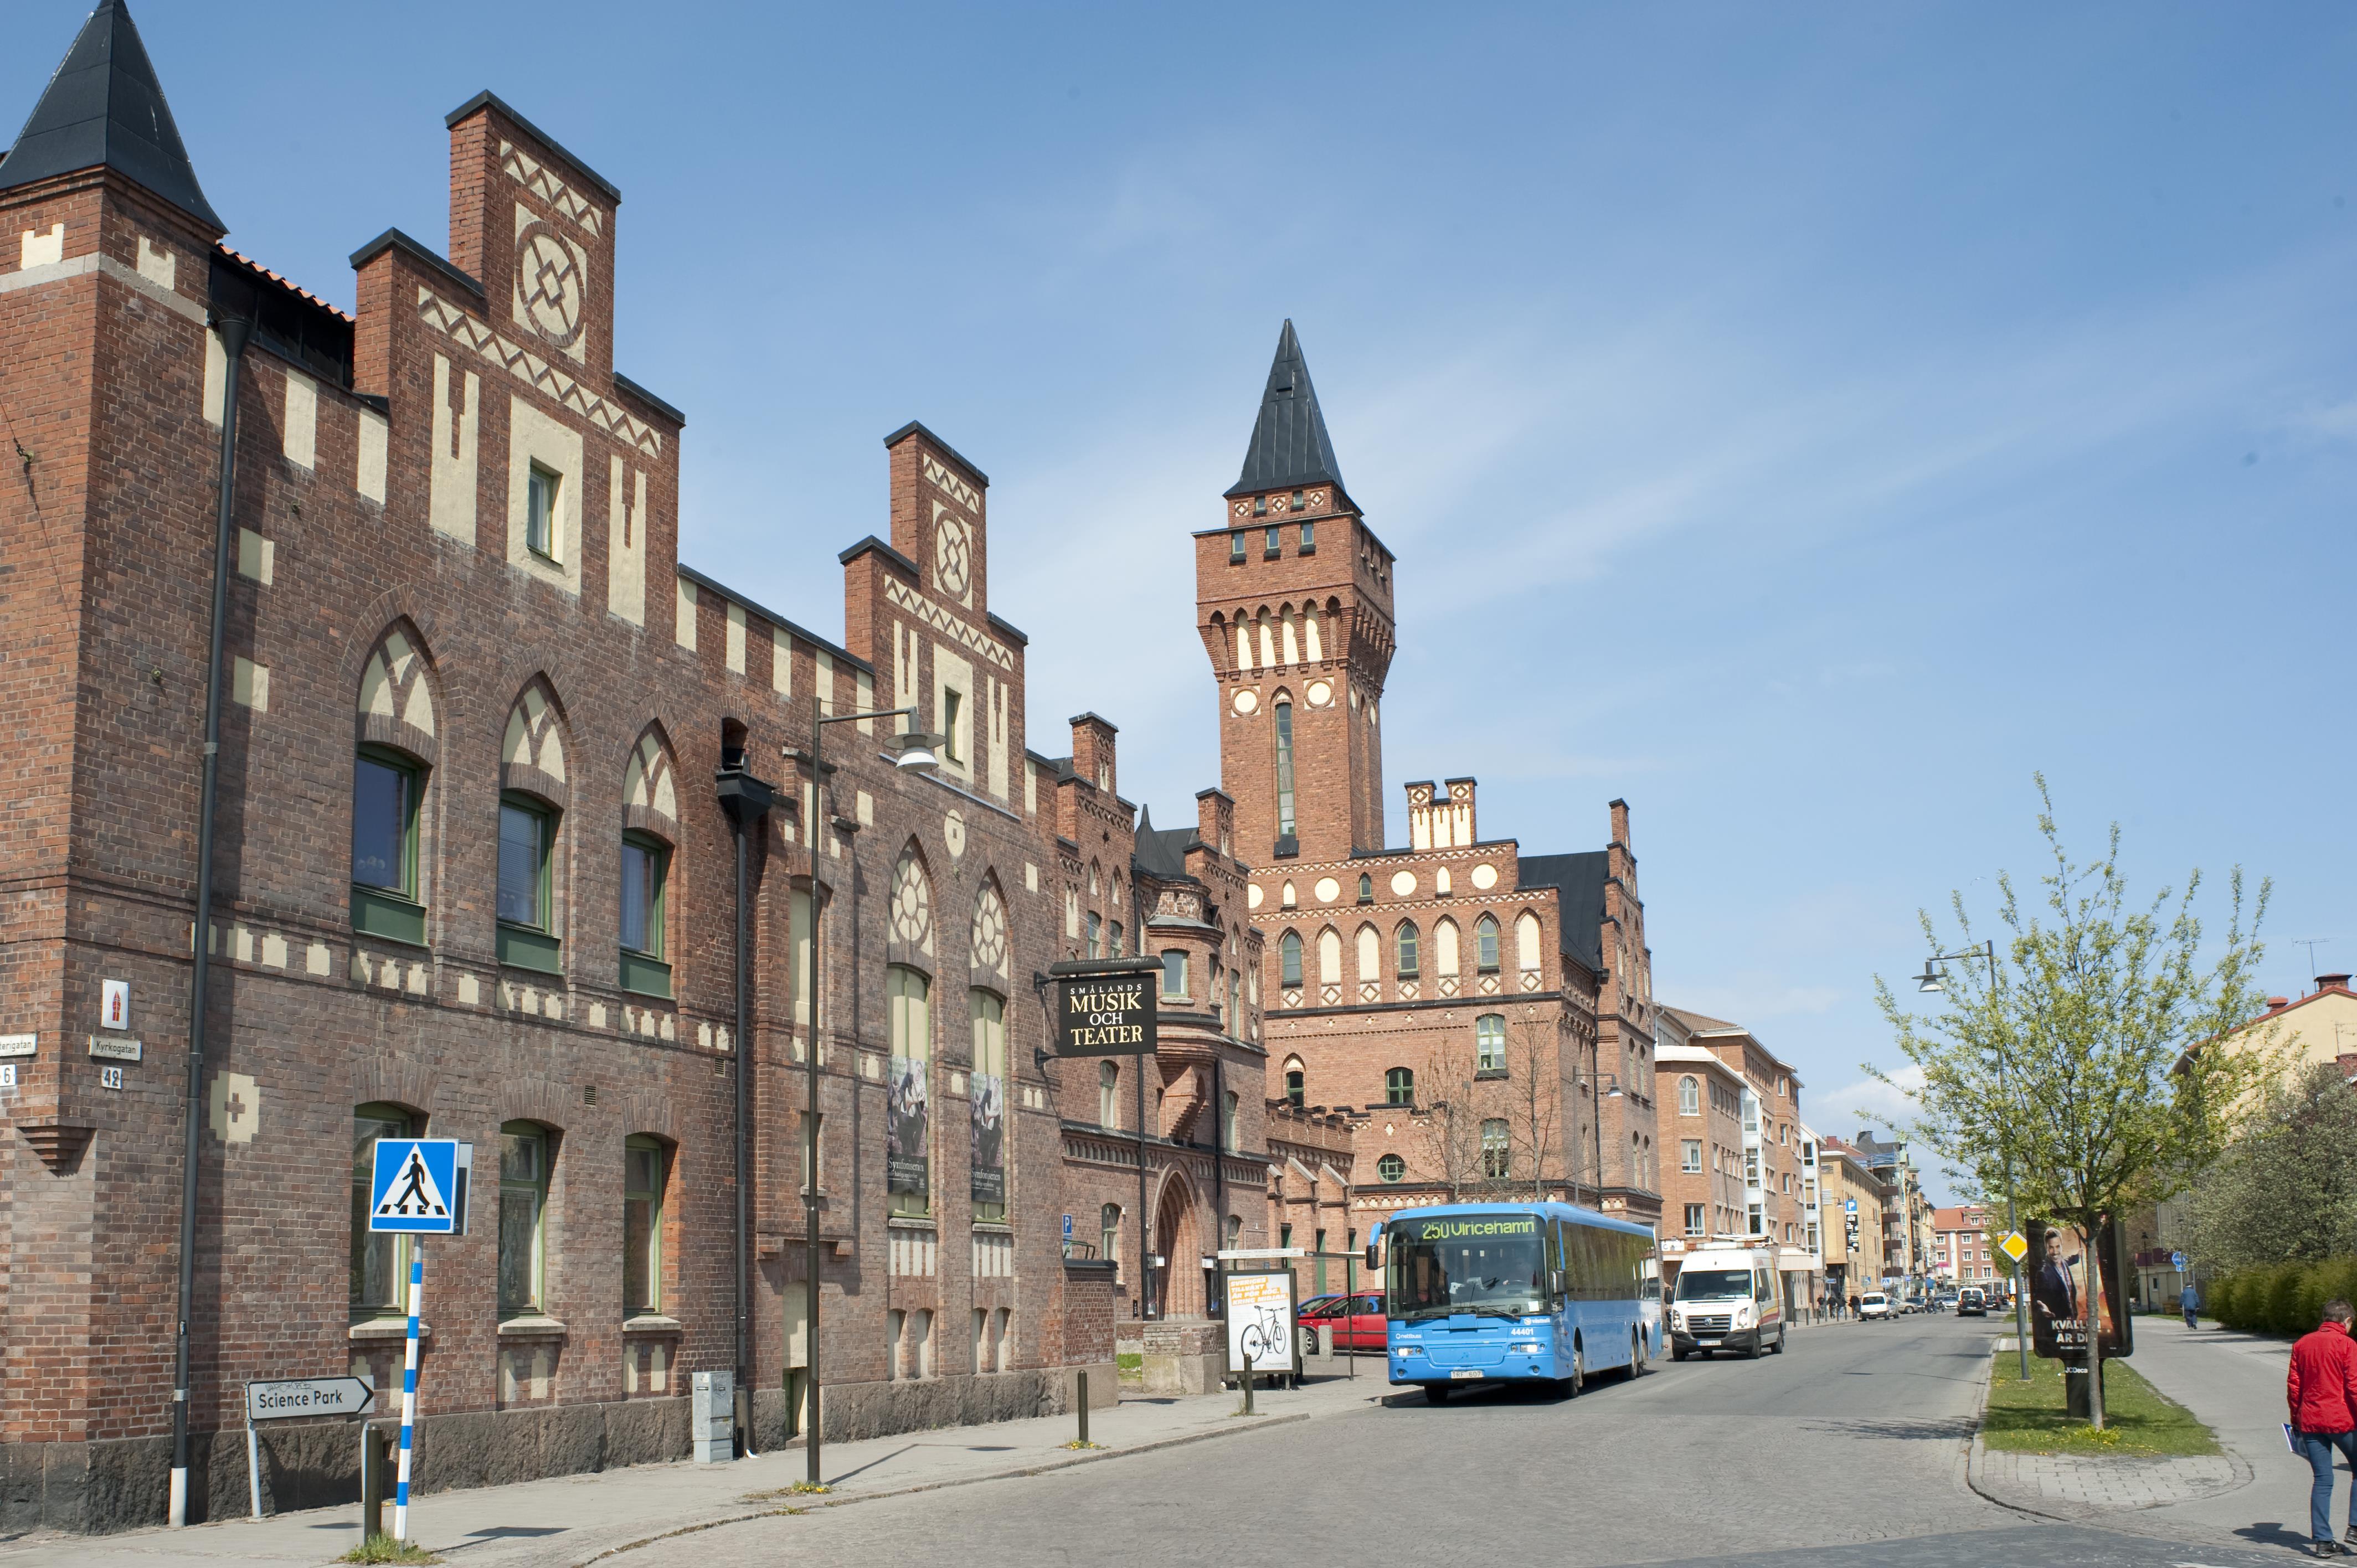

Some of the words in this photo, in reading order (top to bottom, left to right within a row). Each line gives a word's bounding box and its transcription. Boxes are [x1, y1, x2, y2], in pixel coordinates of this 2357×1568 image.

[1070, 983, 1142, 995] SMÅLANDS
[1070, 992, 1143, 1013] MUSIK
[1089, 1012, 1123, 1025] OCH
[1071, 1025, 1143, 1045] TEATER
[0, 1040, 32, 1052] terigatan
[96, 1040, 136, 1055] Kyrkogatan
[4, 1067, 11, 1084] 6
[104, 1069, 119, 1086] 42
[1848, 1201, 1855, 1210] P
[1065, 1216, 1069, 1232] P
[1422, 1221, 1450, 1240] 250
[1450, 1220, 1535, 1236] Ulricehamn
[1231, 1277, 1267, 1286] SVERIGES
[1231, 1283, 1265, 1293] TILLVÄXT
[1511, 1328, 1534, 1336] 44401
[2056, 1330, 2073, 1343] ÄR
[259, 1392, 309, 1409] Science
[313, 1389, 343, 1405] Park
